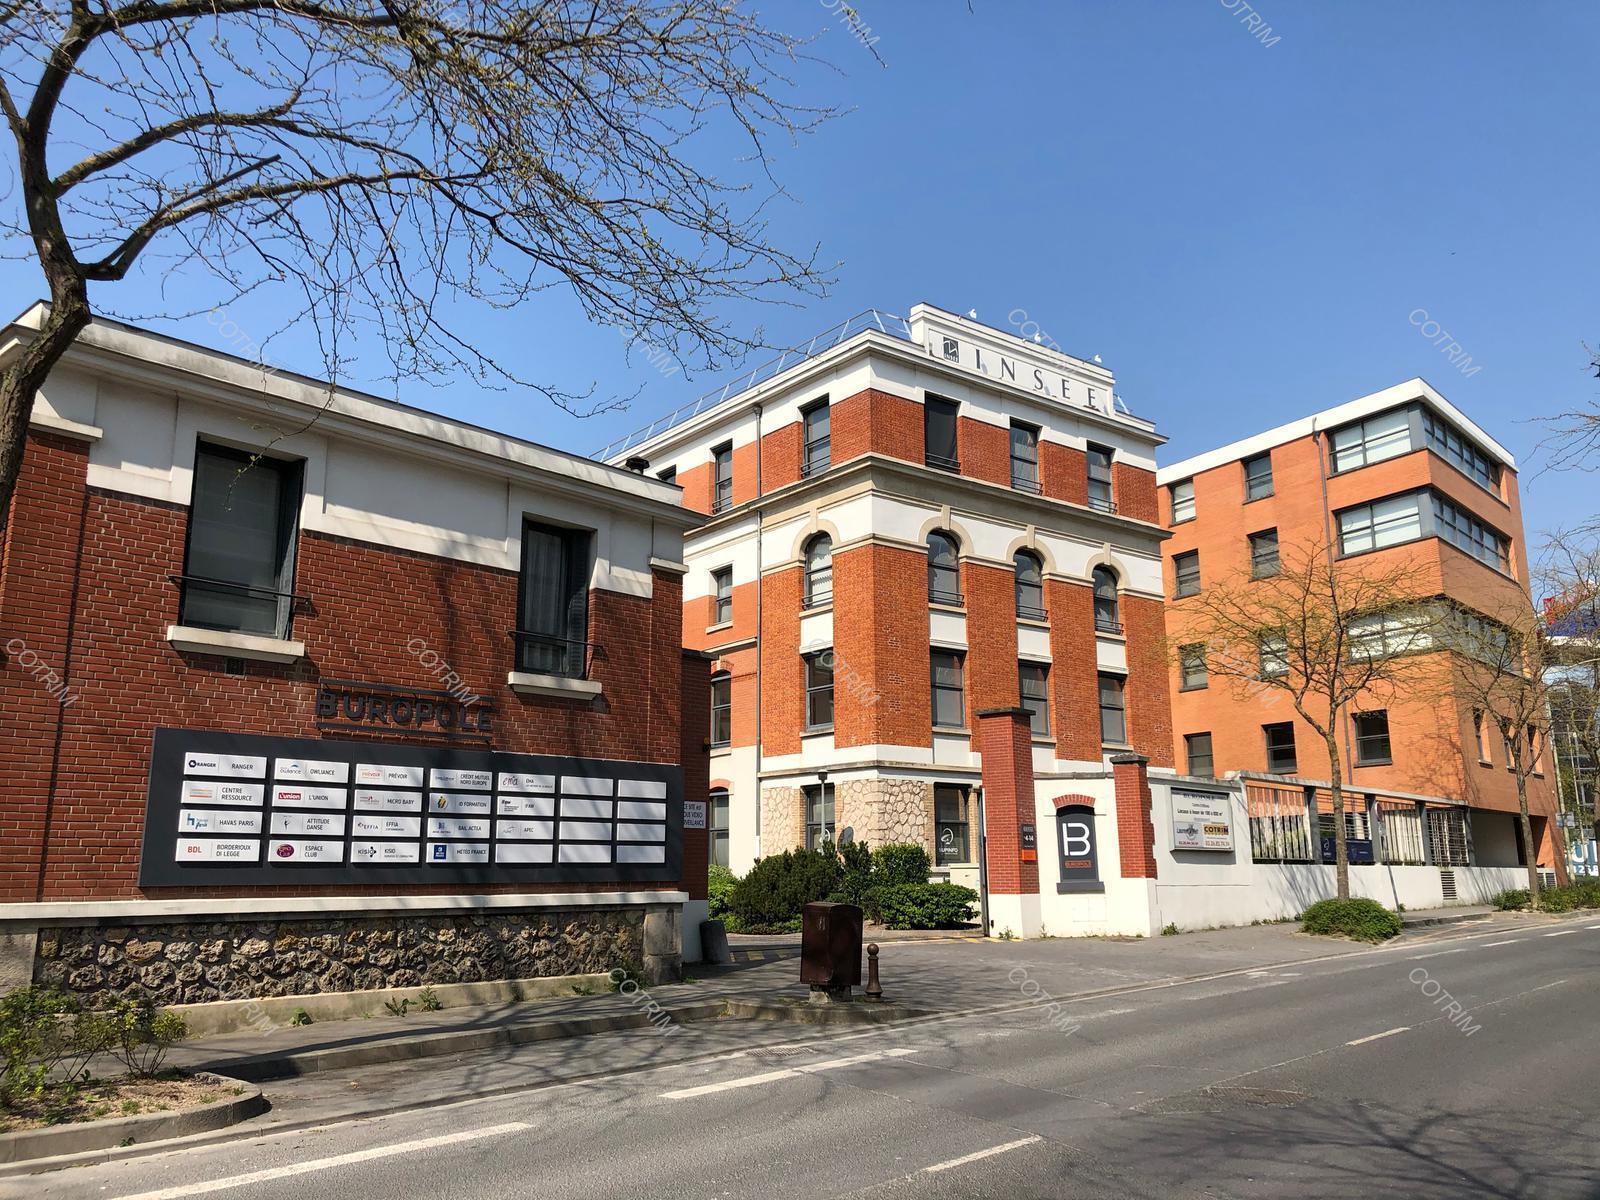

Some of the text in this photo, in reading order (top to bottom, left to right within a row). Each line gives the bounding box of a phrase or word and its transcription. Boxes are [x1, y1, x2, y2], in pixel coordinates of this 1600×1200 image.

[975, 348, 1096, 409] INSEE
[315, 688, 497, 732] BUROPOLE
[221, 794, 253, 802] RESSOURCE
[187, 846, 203, 854] BDL
[1062, 822, 1091, 856] B
